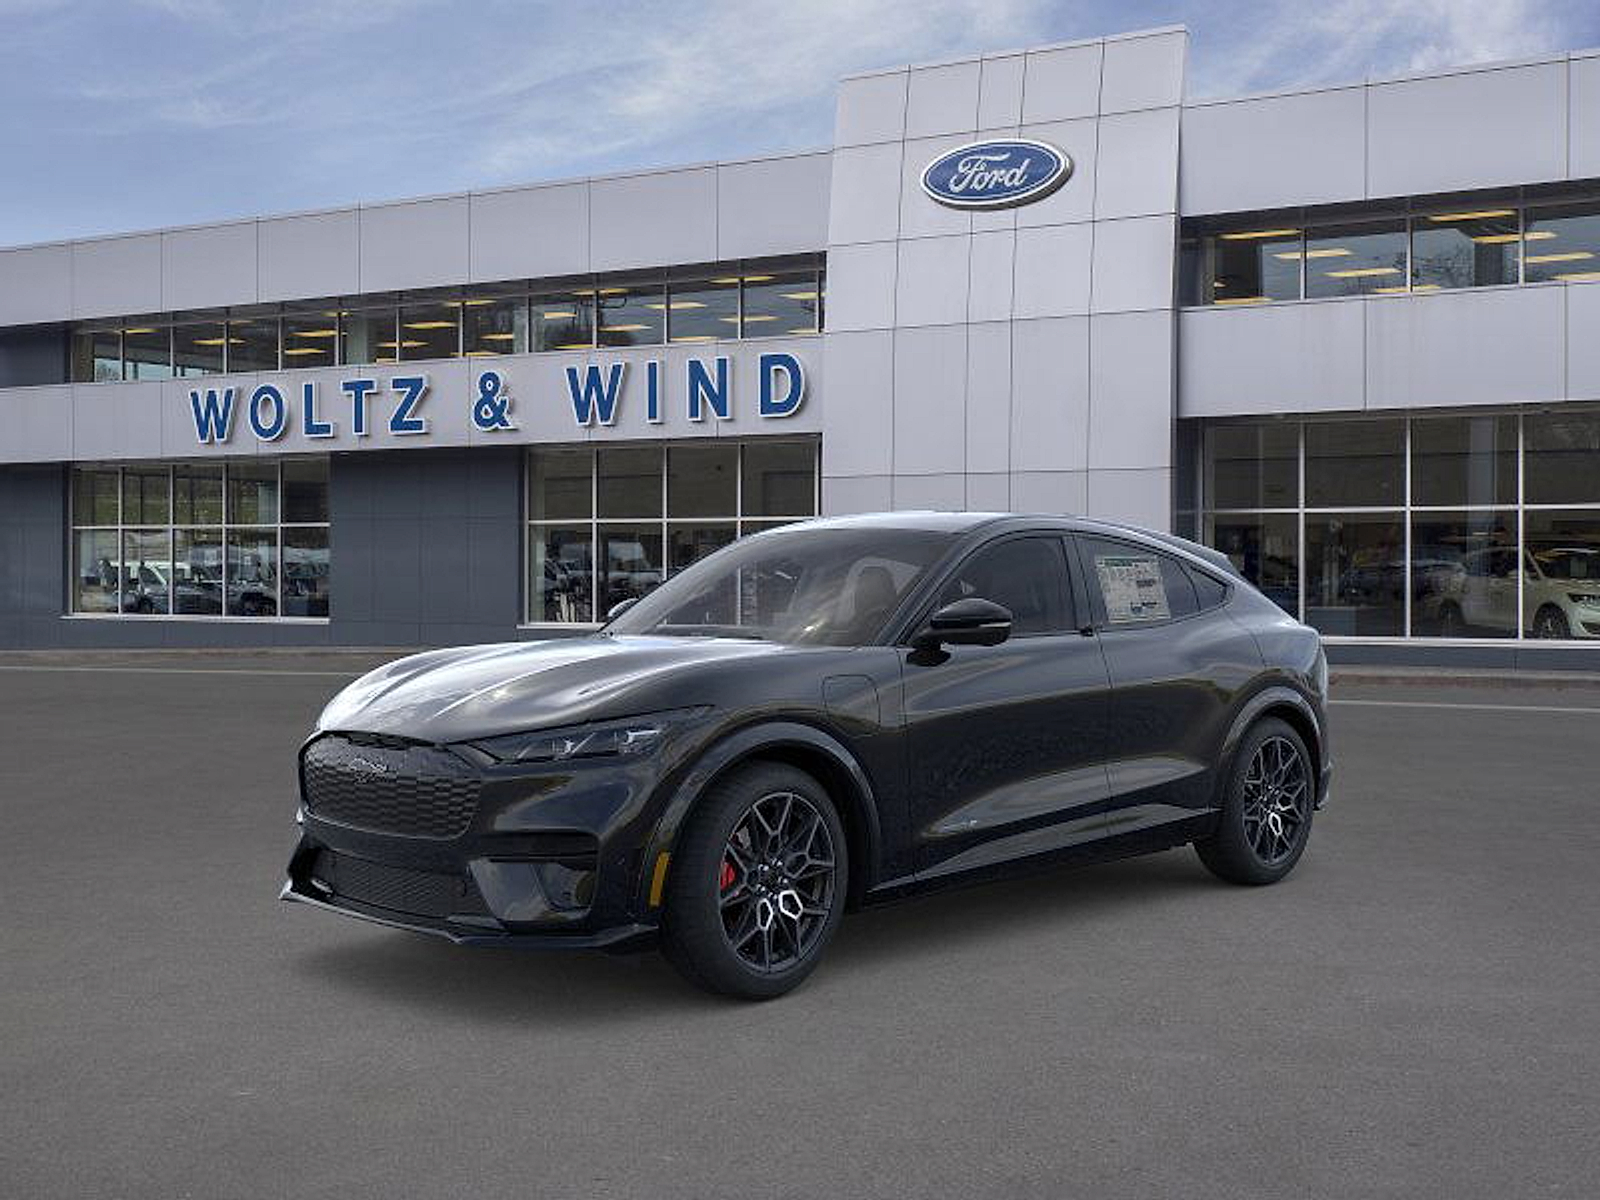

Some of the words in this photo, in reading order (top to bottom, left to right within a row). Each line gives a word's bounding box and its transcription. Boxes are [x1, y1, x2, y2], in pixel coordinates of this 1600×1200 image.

[949, 152, 1031, 193] Ford
[190, 375, 429, 443] WOLTZ
[472, 371, 513, 431] &
[566, 352, 806, 426] WIND
